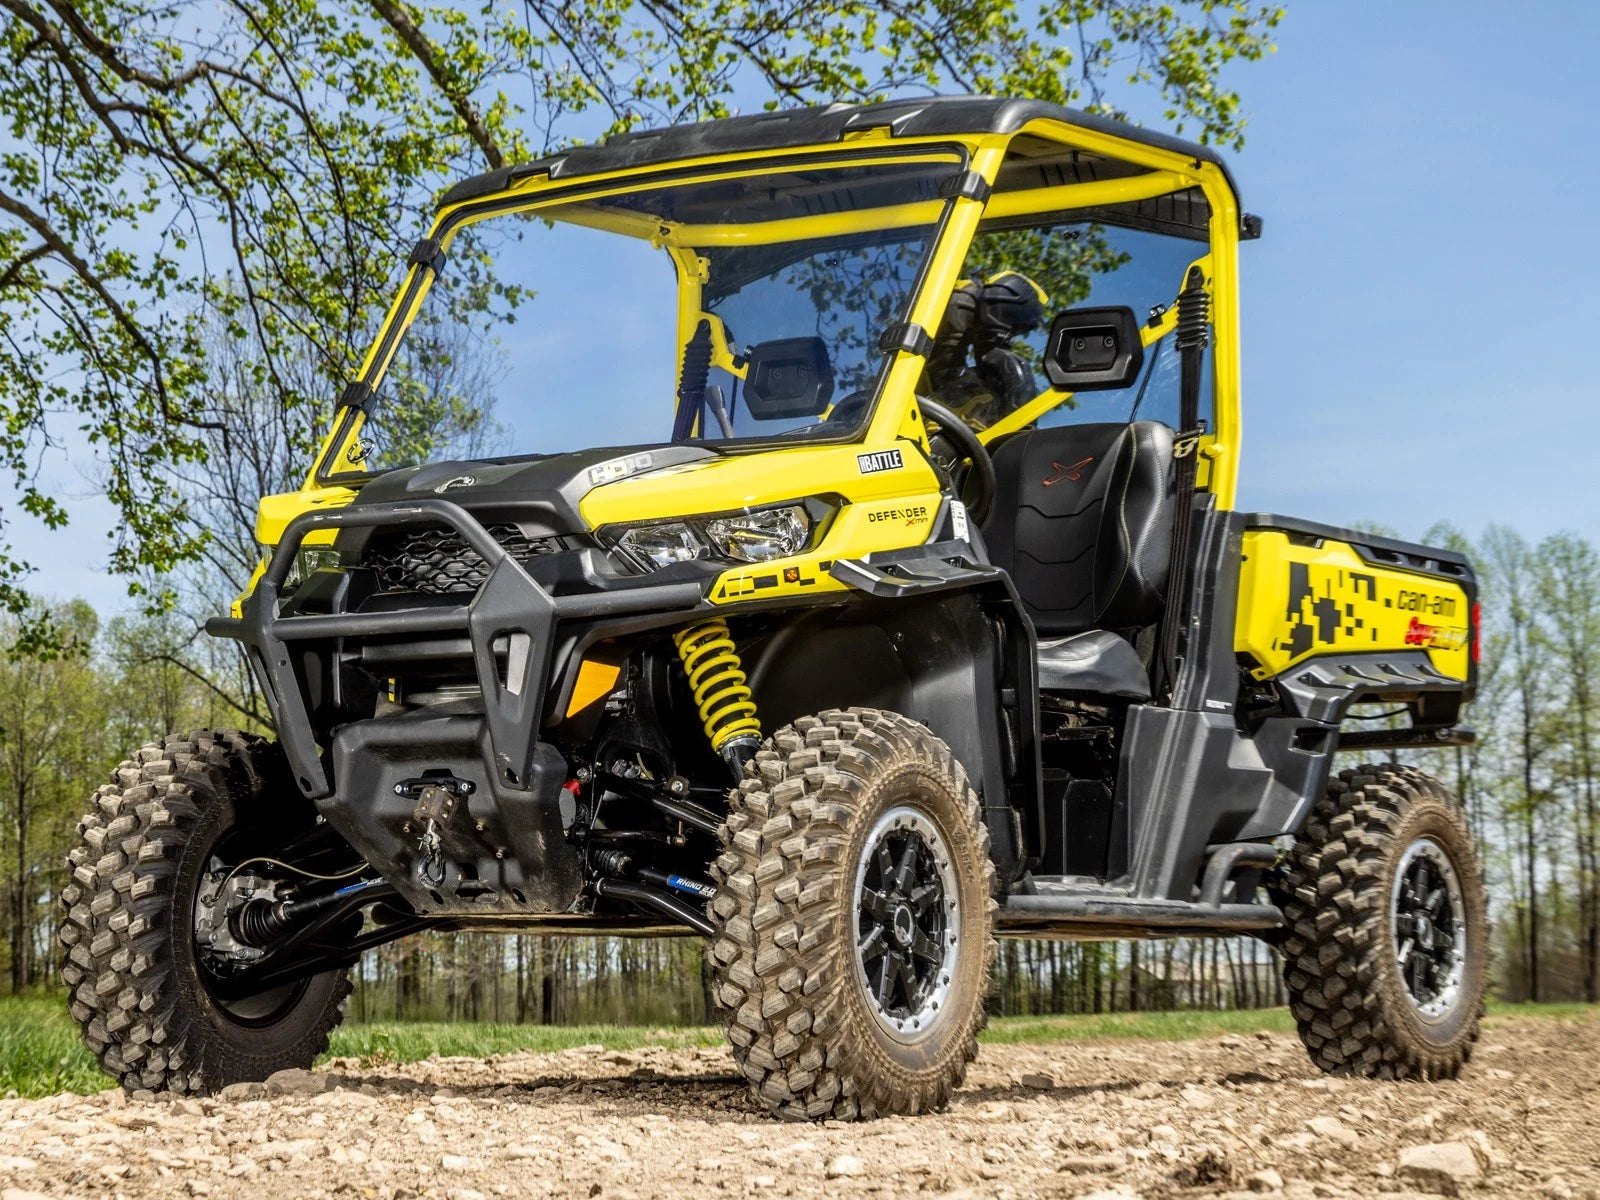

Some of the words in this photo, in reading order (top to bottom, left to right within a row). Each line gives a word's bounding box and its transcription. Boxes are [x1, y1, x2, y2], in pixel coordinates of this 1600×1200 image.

[864, 451, 902, 472] BATTLE
[868, 507, 927, 523] DEFENDER
[1398, 590, 1456, 618] can-am
[676, 878, 702, 890] RHINO
